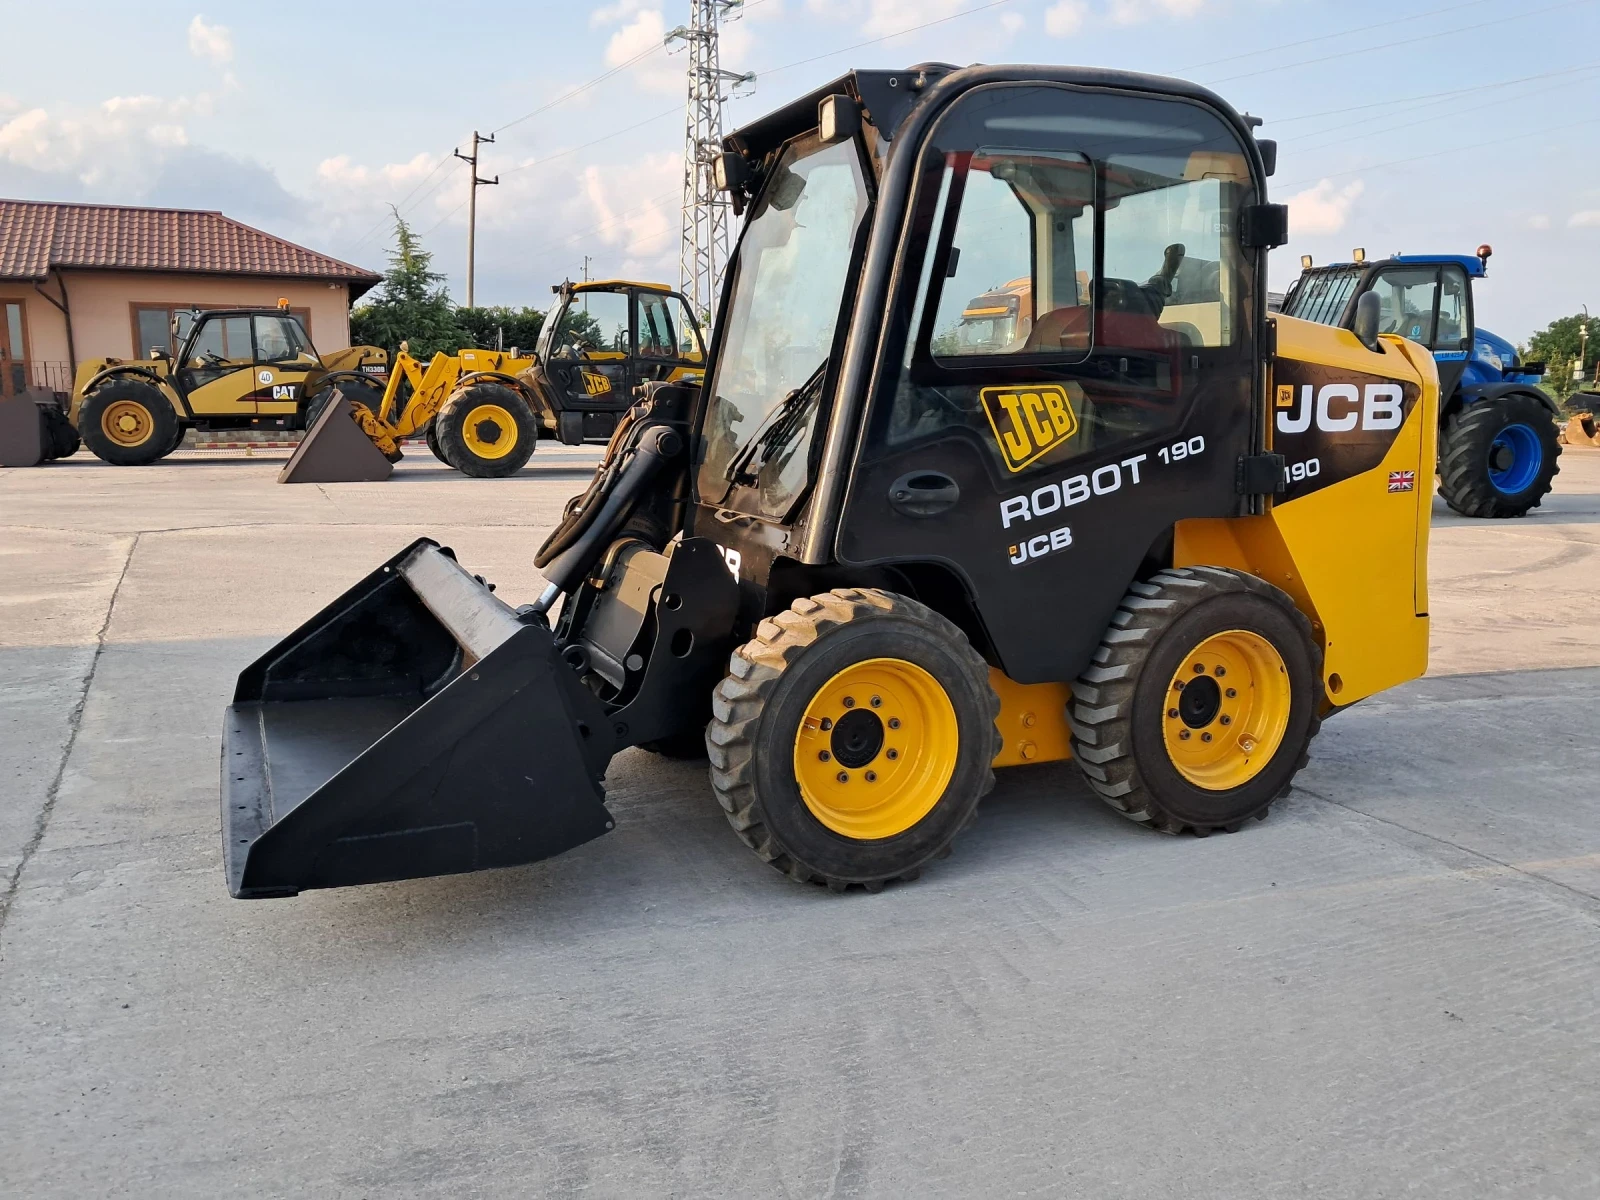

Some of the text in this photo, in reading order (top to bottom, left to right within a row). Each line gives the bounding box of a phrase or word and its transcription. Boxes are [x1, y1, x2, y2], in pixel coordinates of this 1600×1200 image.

[261, 373, 271, 382] 40
[272, 386, 296, 400] CAT
[586, 375, 610, 394] JCB
[1276, 383, 1404, 434] JCB
[997, 392, 1071, 461] JCB
[999, 435, 1205, 529] ROBOT 190
[1284, 457, 1321, 484] 190
[1009, 526, 1073, 565] JCB
